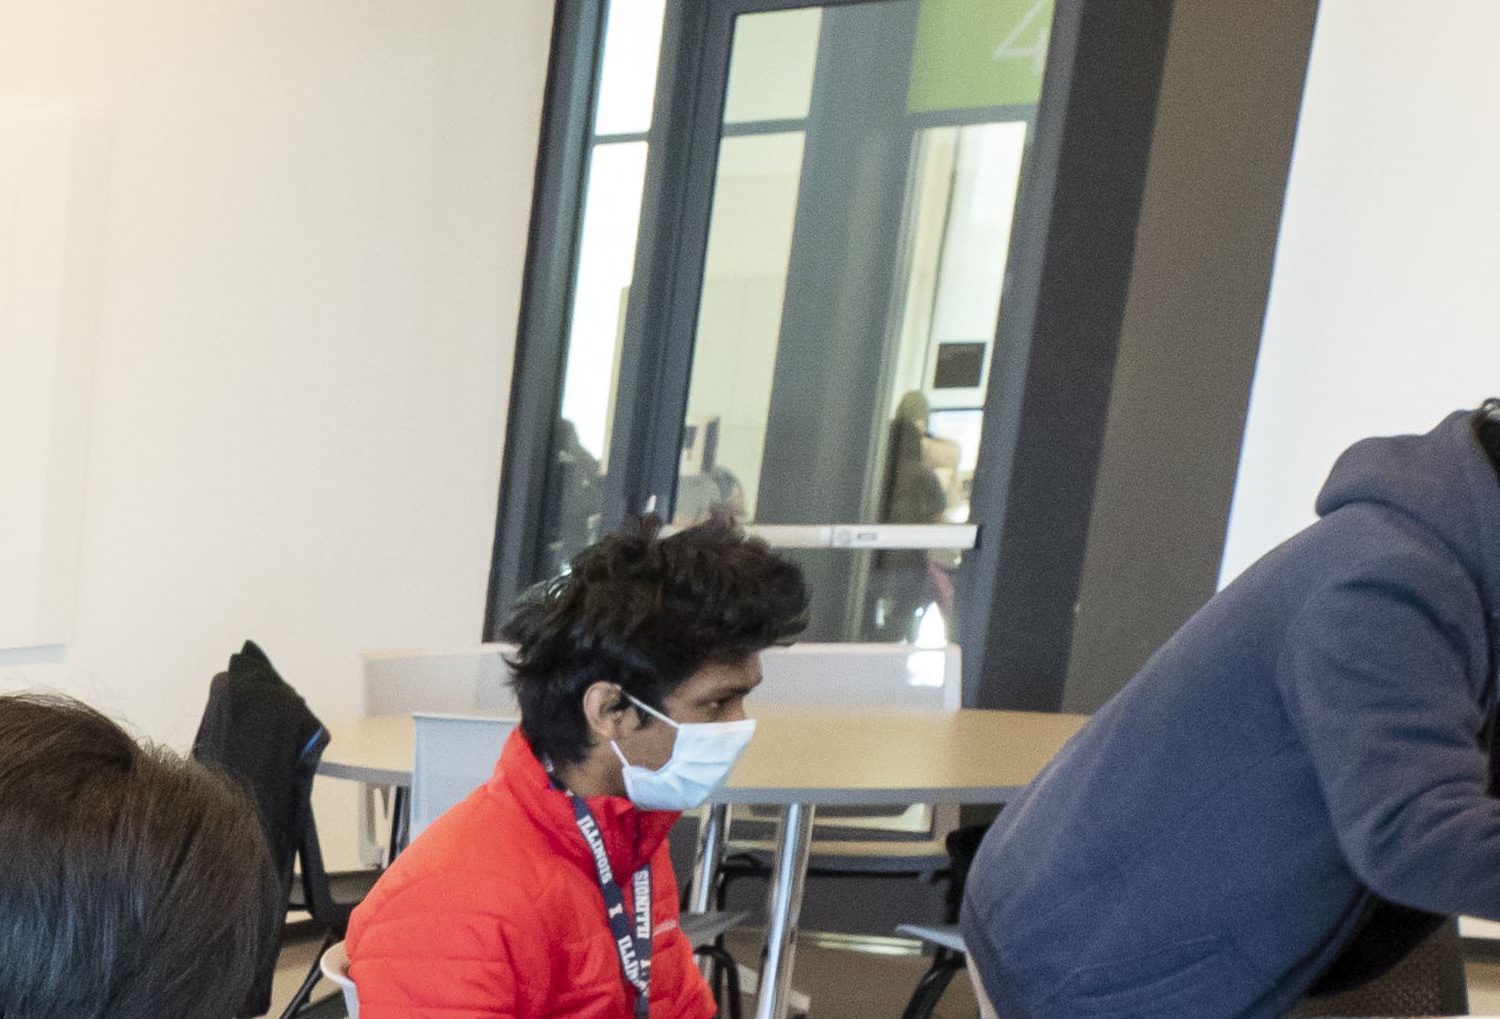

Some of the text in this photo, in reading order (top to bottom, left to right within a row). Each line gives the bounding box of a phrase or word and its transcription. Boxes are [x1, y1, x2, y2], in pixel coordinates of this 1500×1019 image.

[576, 815, 613, 884] ILLINOIS
[635, 869, 650, 939] ILLINOIS
[618, 935, 649, 995] ILLIN
